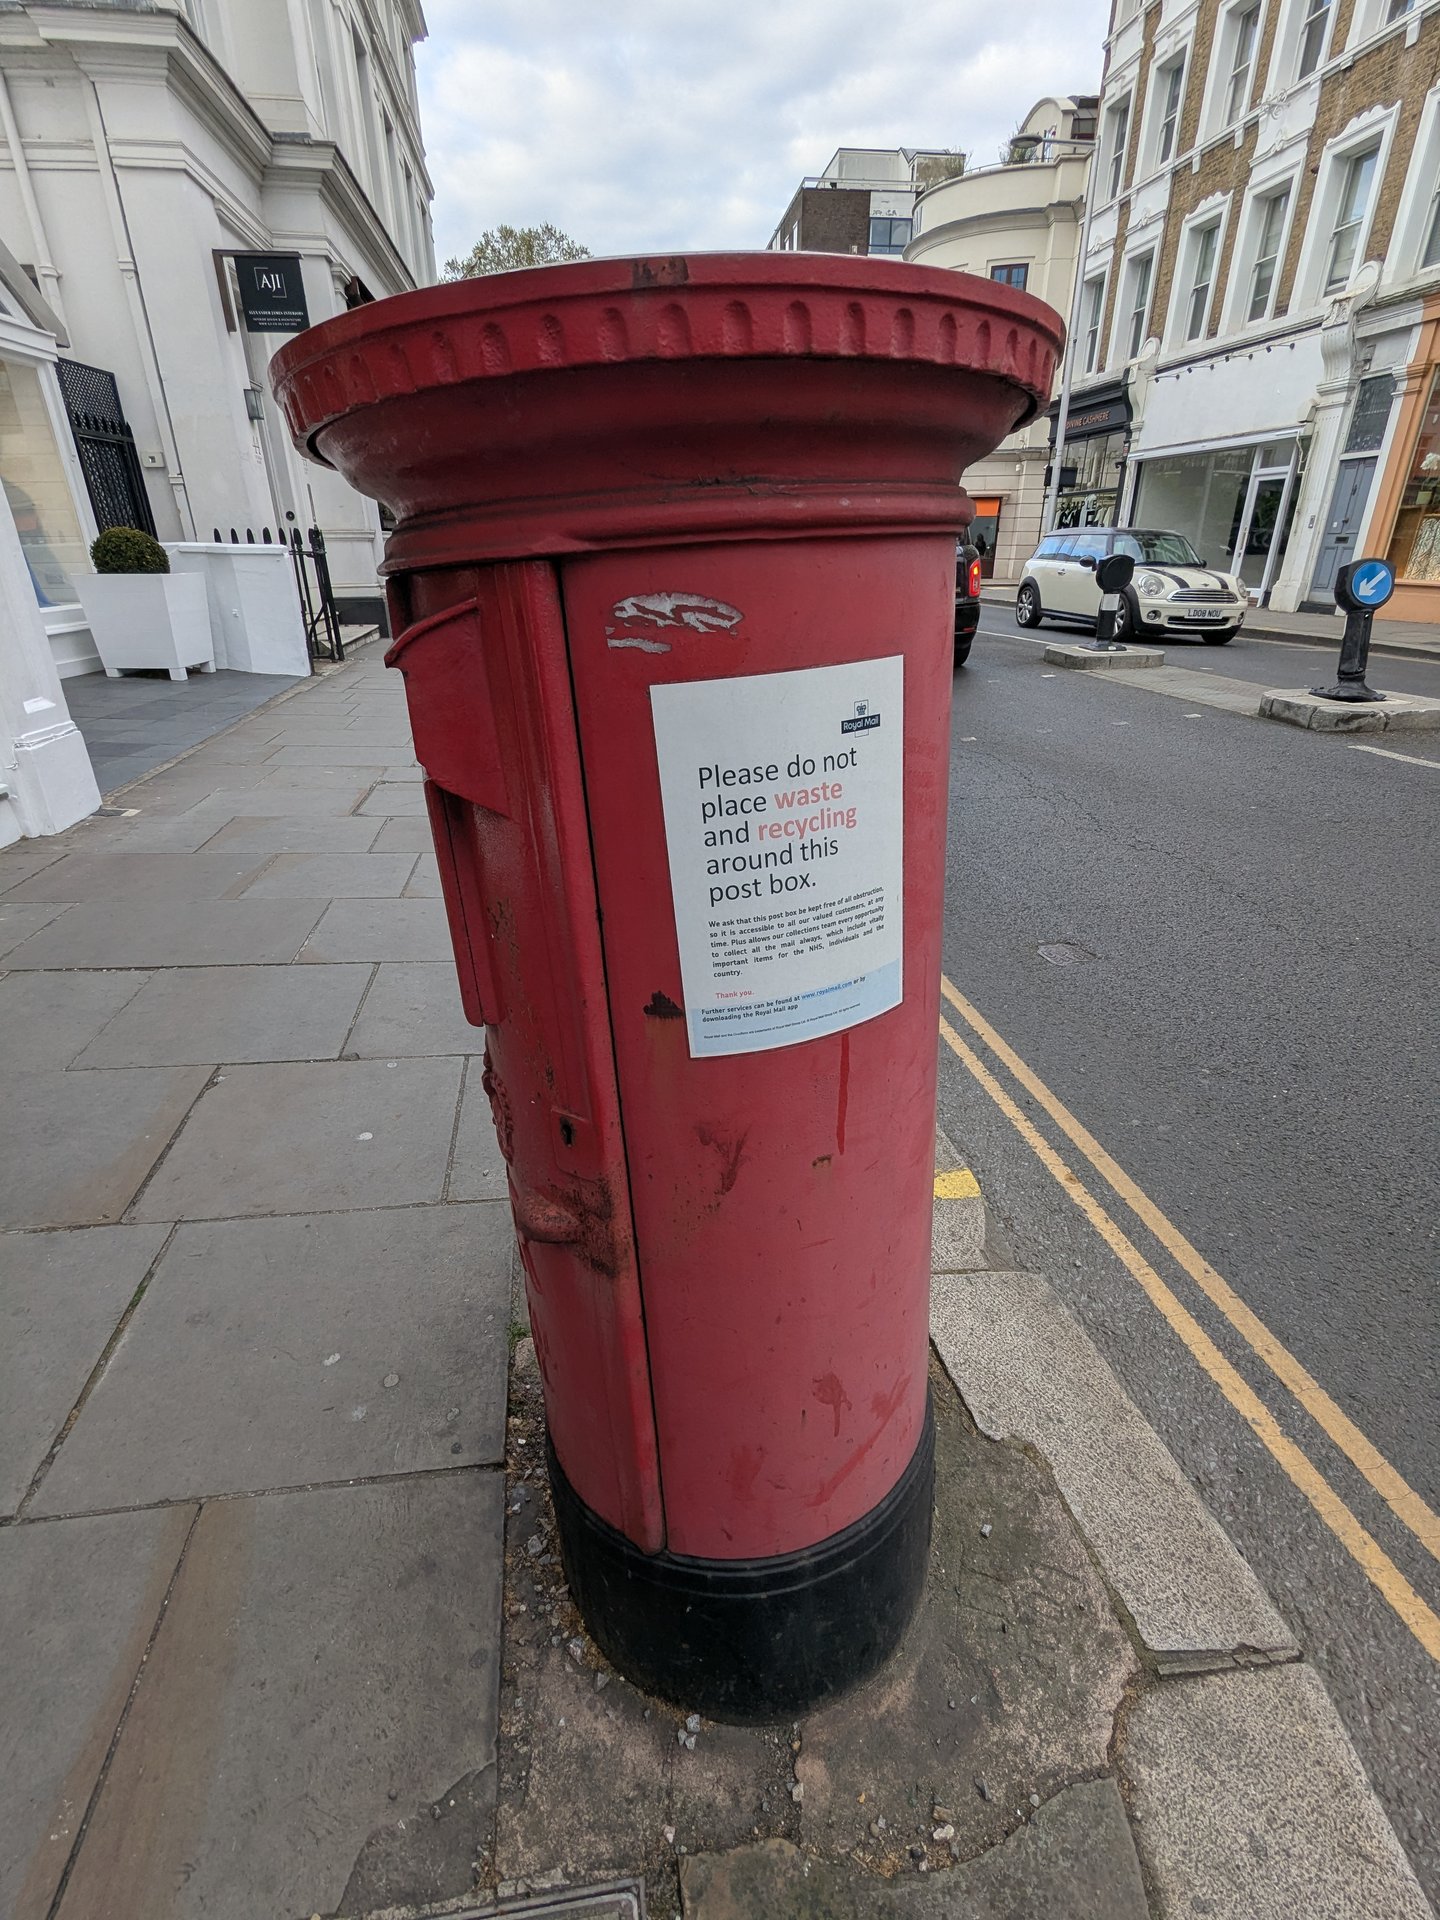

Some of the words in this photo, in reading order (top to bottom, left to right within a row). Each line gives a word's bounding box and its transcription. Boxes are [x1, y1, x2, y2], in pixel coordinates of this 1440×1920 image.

[261, 274, 281, 292] AJI
[1060, 500, 1097, 510] SAMPLE
[844, 719, 863, 730] Royal
[864, 716, 878, 726] Mail
[699, 764, 779, 789] Please
[787, 754, 815, 778] do
[824, 747, 857, 772] not
[702, 794, 767, 824] place
[774, 782, 842, 809] waste
[704, 820, 749, 847] and
[758, 807, 857, 840] recycling
[707, 842, 792, 874] around
[800, 836, 838, 861] this
[710, 879, 762, 907] post
[770, 873, 816, 895] box.
[768, 912, 783, 922] post
[808, 904, 822, 912] kept
[823, 901, 836, 909] free
[853, 886, 884, 901] obstruction,
[724, 949, 747, 957] collect
[781, 940, 795, 948] mail
[800, 935, 822, 944] always,
[826, 929, 843, 938] which
[847, 922, 866, 932] include
[869, 915, 884, 924] vitally
[739, 924, 774, 935] accessible
[812, 911, 833, 921] valued
[835, 902, 866, 916] customers,
[748, 935, 770, 944] allows
[786, 926, 820, 938] collections
[821, 921, 837, 930] team
[838, 916, 853, 925] every
[854, 905, 884, 920] opportunity
[713, 958, 748, 968] important
[829, 933, 859, 946] individuals
[775, 996, 792, 1006] found
[801, 981, 852, 1000] www.royalmail.com
